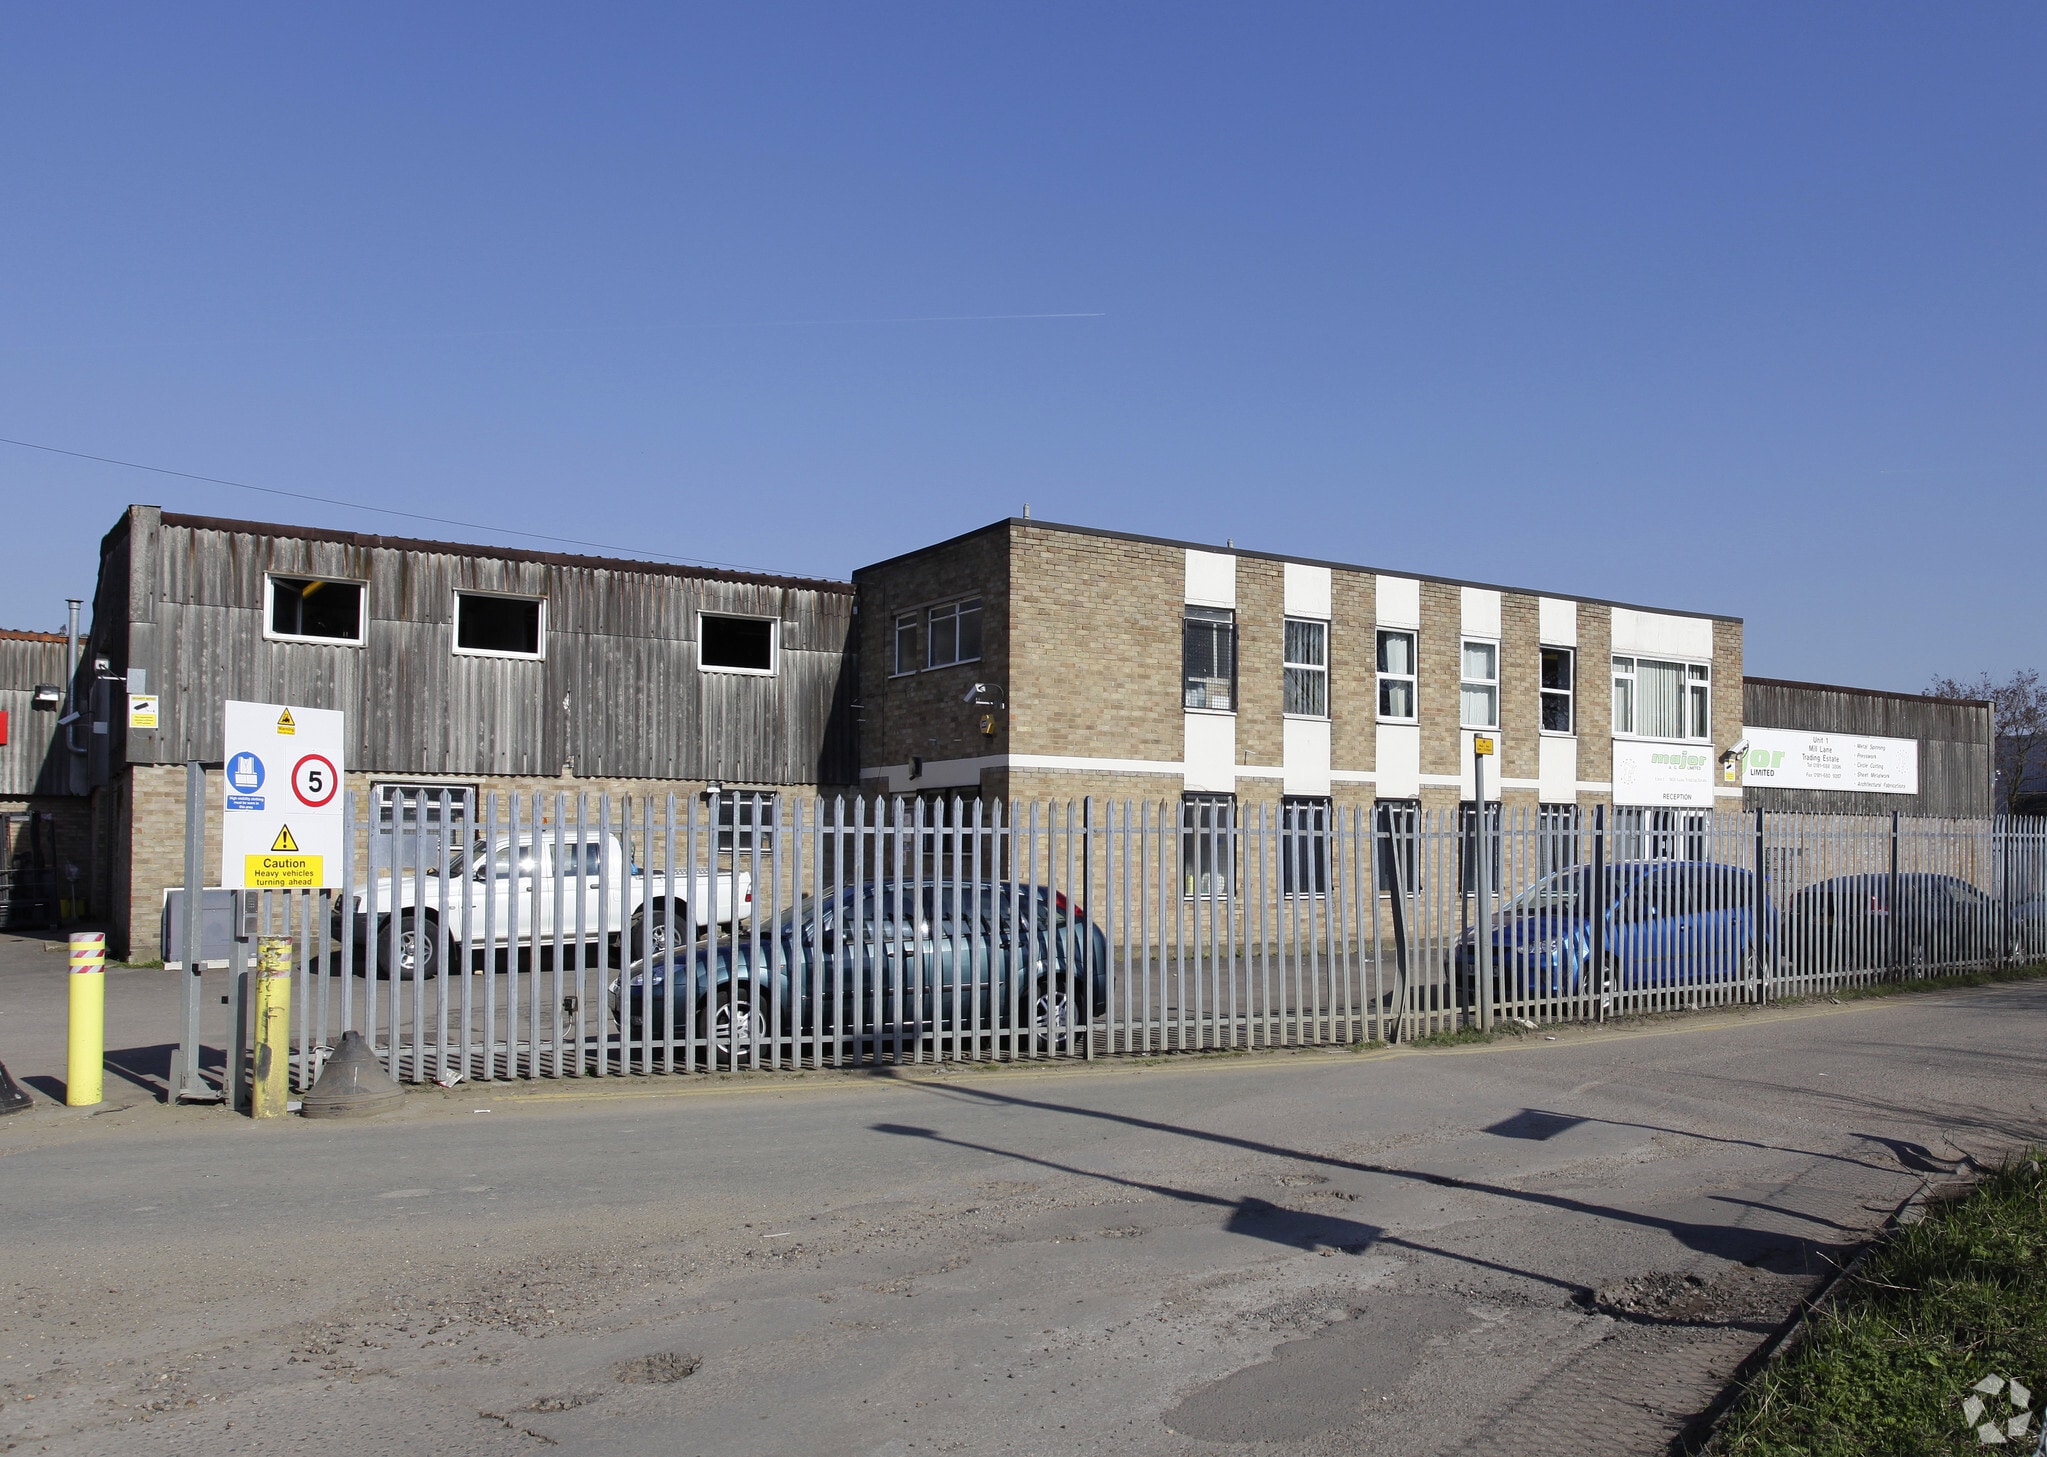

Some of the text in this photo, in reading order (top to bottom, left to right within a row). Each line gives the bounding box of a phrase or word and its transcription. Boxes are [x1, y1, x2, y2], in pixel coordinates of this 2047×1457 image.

[1651, 751, 1707, 769] major
[1802, 753, 1840, 762] Trading Estate
[1750, 769, 1775, 777] LIMITED
[309, 771, 322, 793] 5
[263, 858, 306, 868] Caution
[254, 870, 279, 878] Heavy
[256, 879, 285, 887] turning
